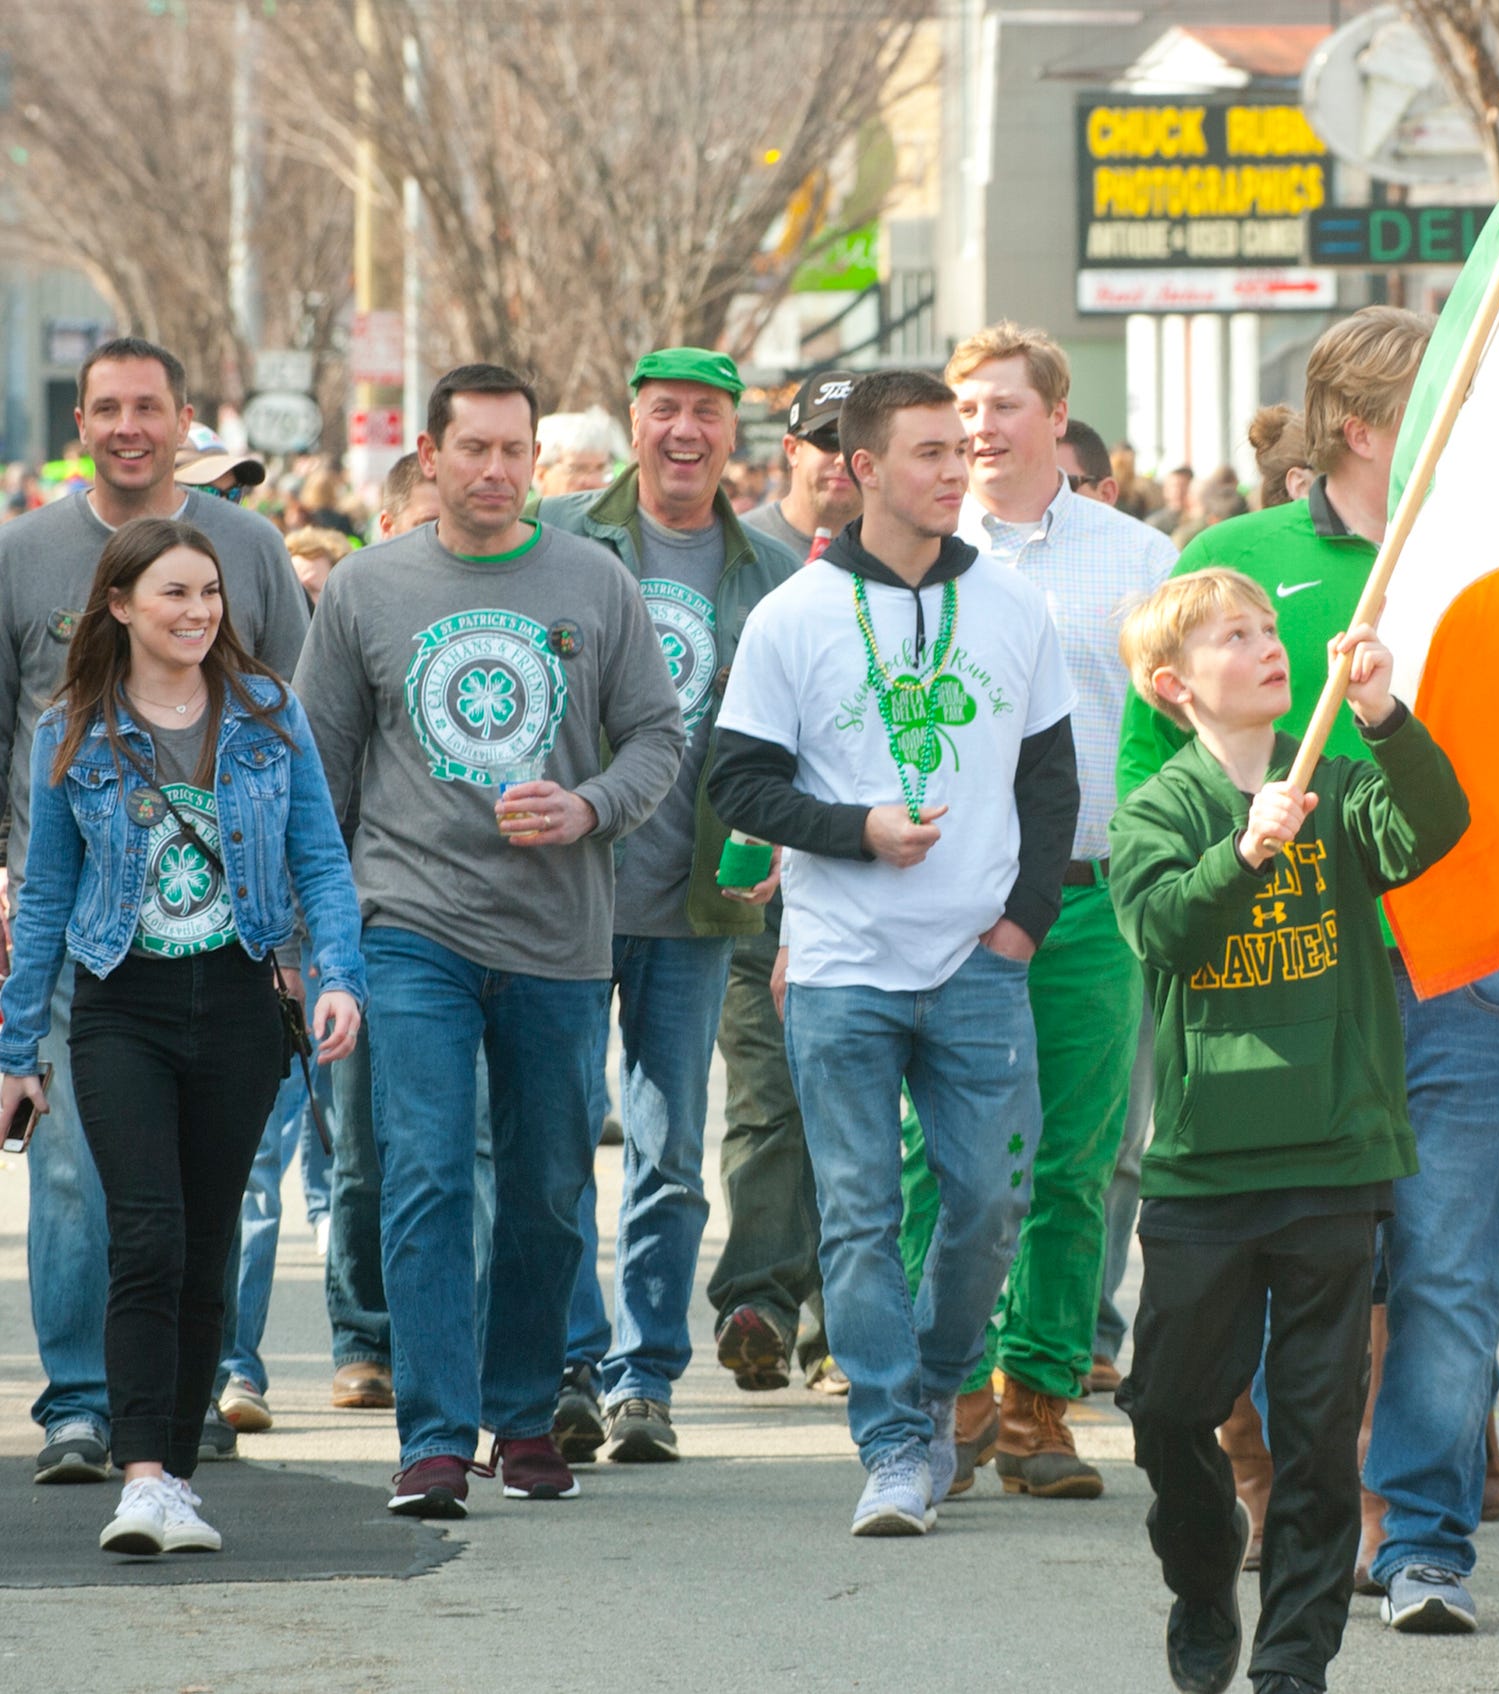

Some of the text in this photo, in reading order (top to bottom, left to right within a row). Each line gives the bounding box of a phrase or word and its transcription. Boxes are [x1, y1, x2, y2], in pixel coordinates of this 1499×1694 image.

[1087, 106, 1207, 158] CHUCK
[1093, 164, 1325, 218] PHOTOGRAPHICS
[458, 613, 517, 630] PATRICK'S
[519, 621, 542, 640] DAY
[694, 599, 714, 617] DAY
[427, 638, 494, 710] CALLAHANS
[511, 648, 545, 713] FRIENDS
[950, 647, 992, 688] Run
